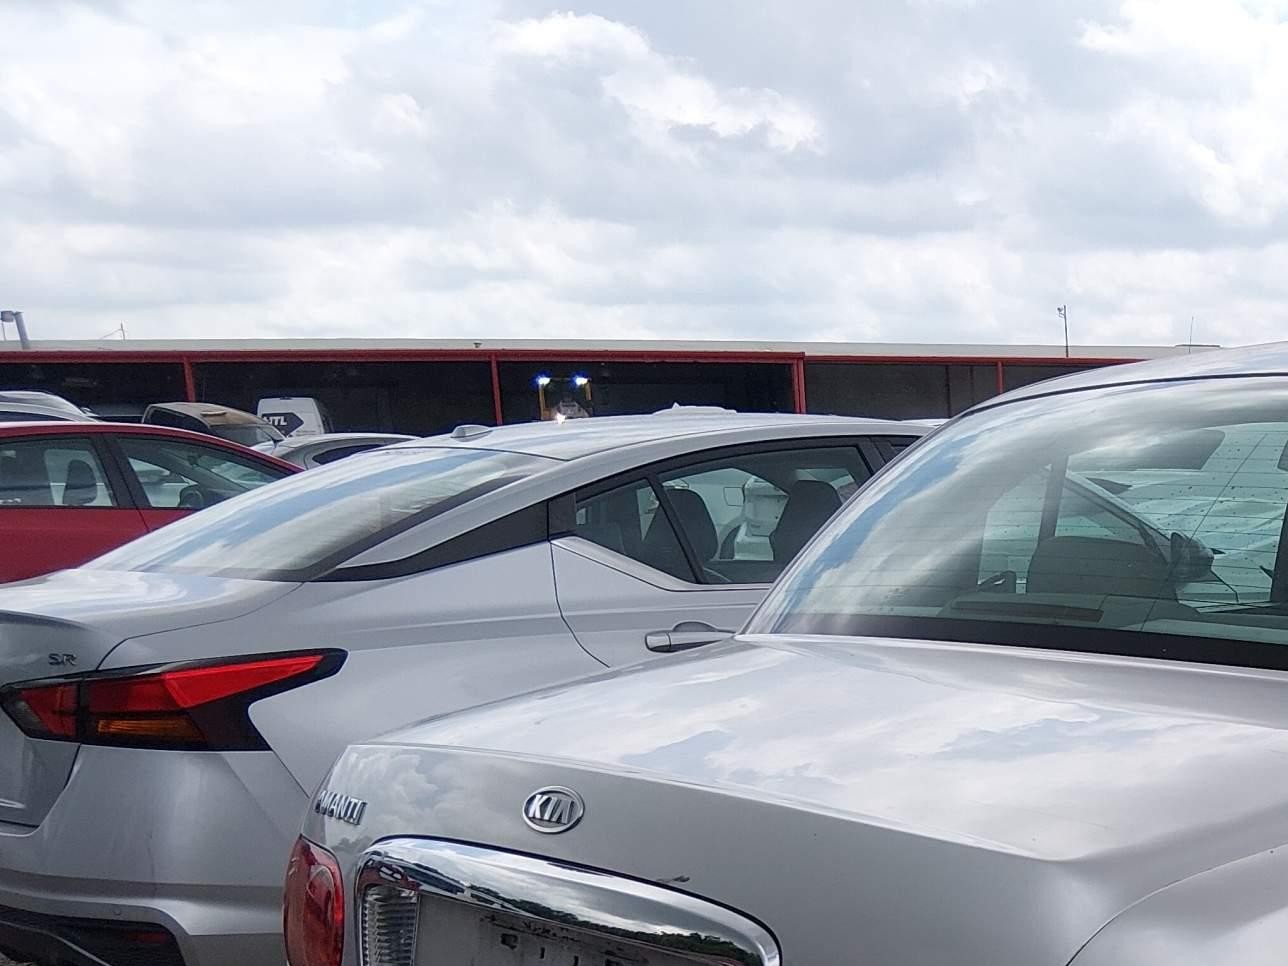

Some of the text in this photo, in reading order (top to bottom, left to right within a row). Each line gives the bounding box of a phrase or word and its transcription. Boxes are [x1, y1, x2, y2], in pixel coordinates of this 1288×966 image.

[48, 652, 77, 666] SR
[314, 790, 368, 826] AMANTI
[528, 794, 574, 826] KIA
